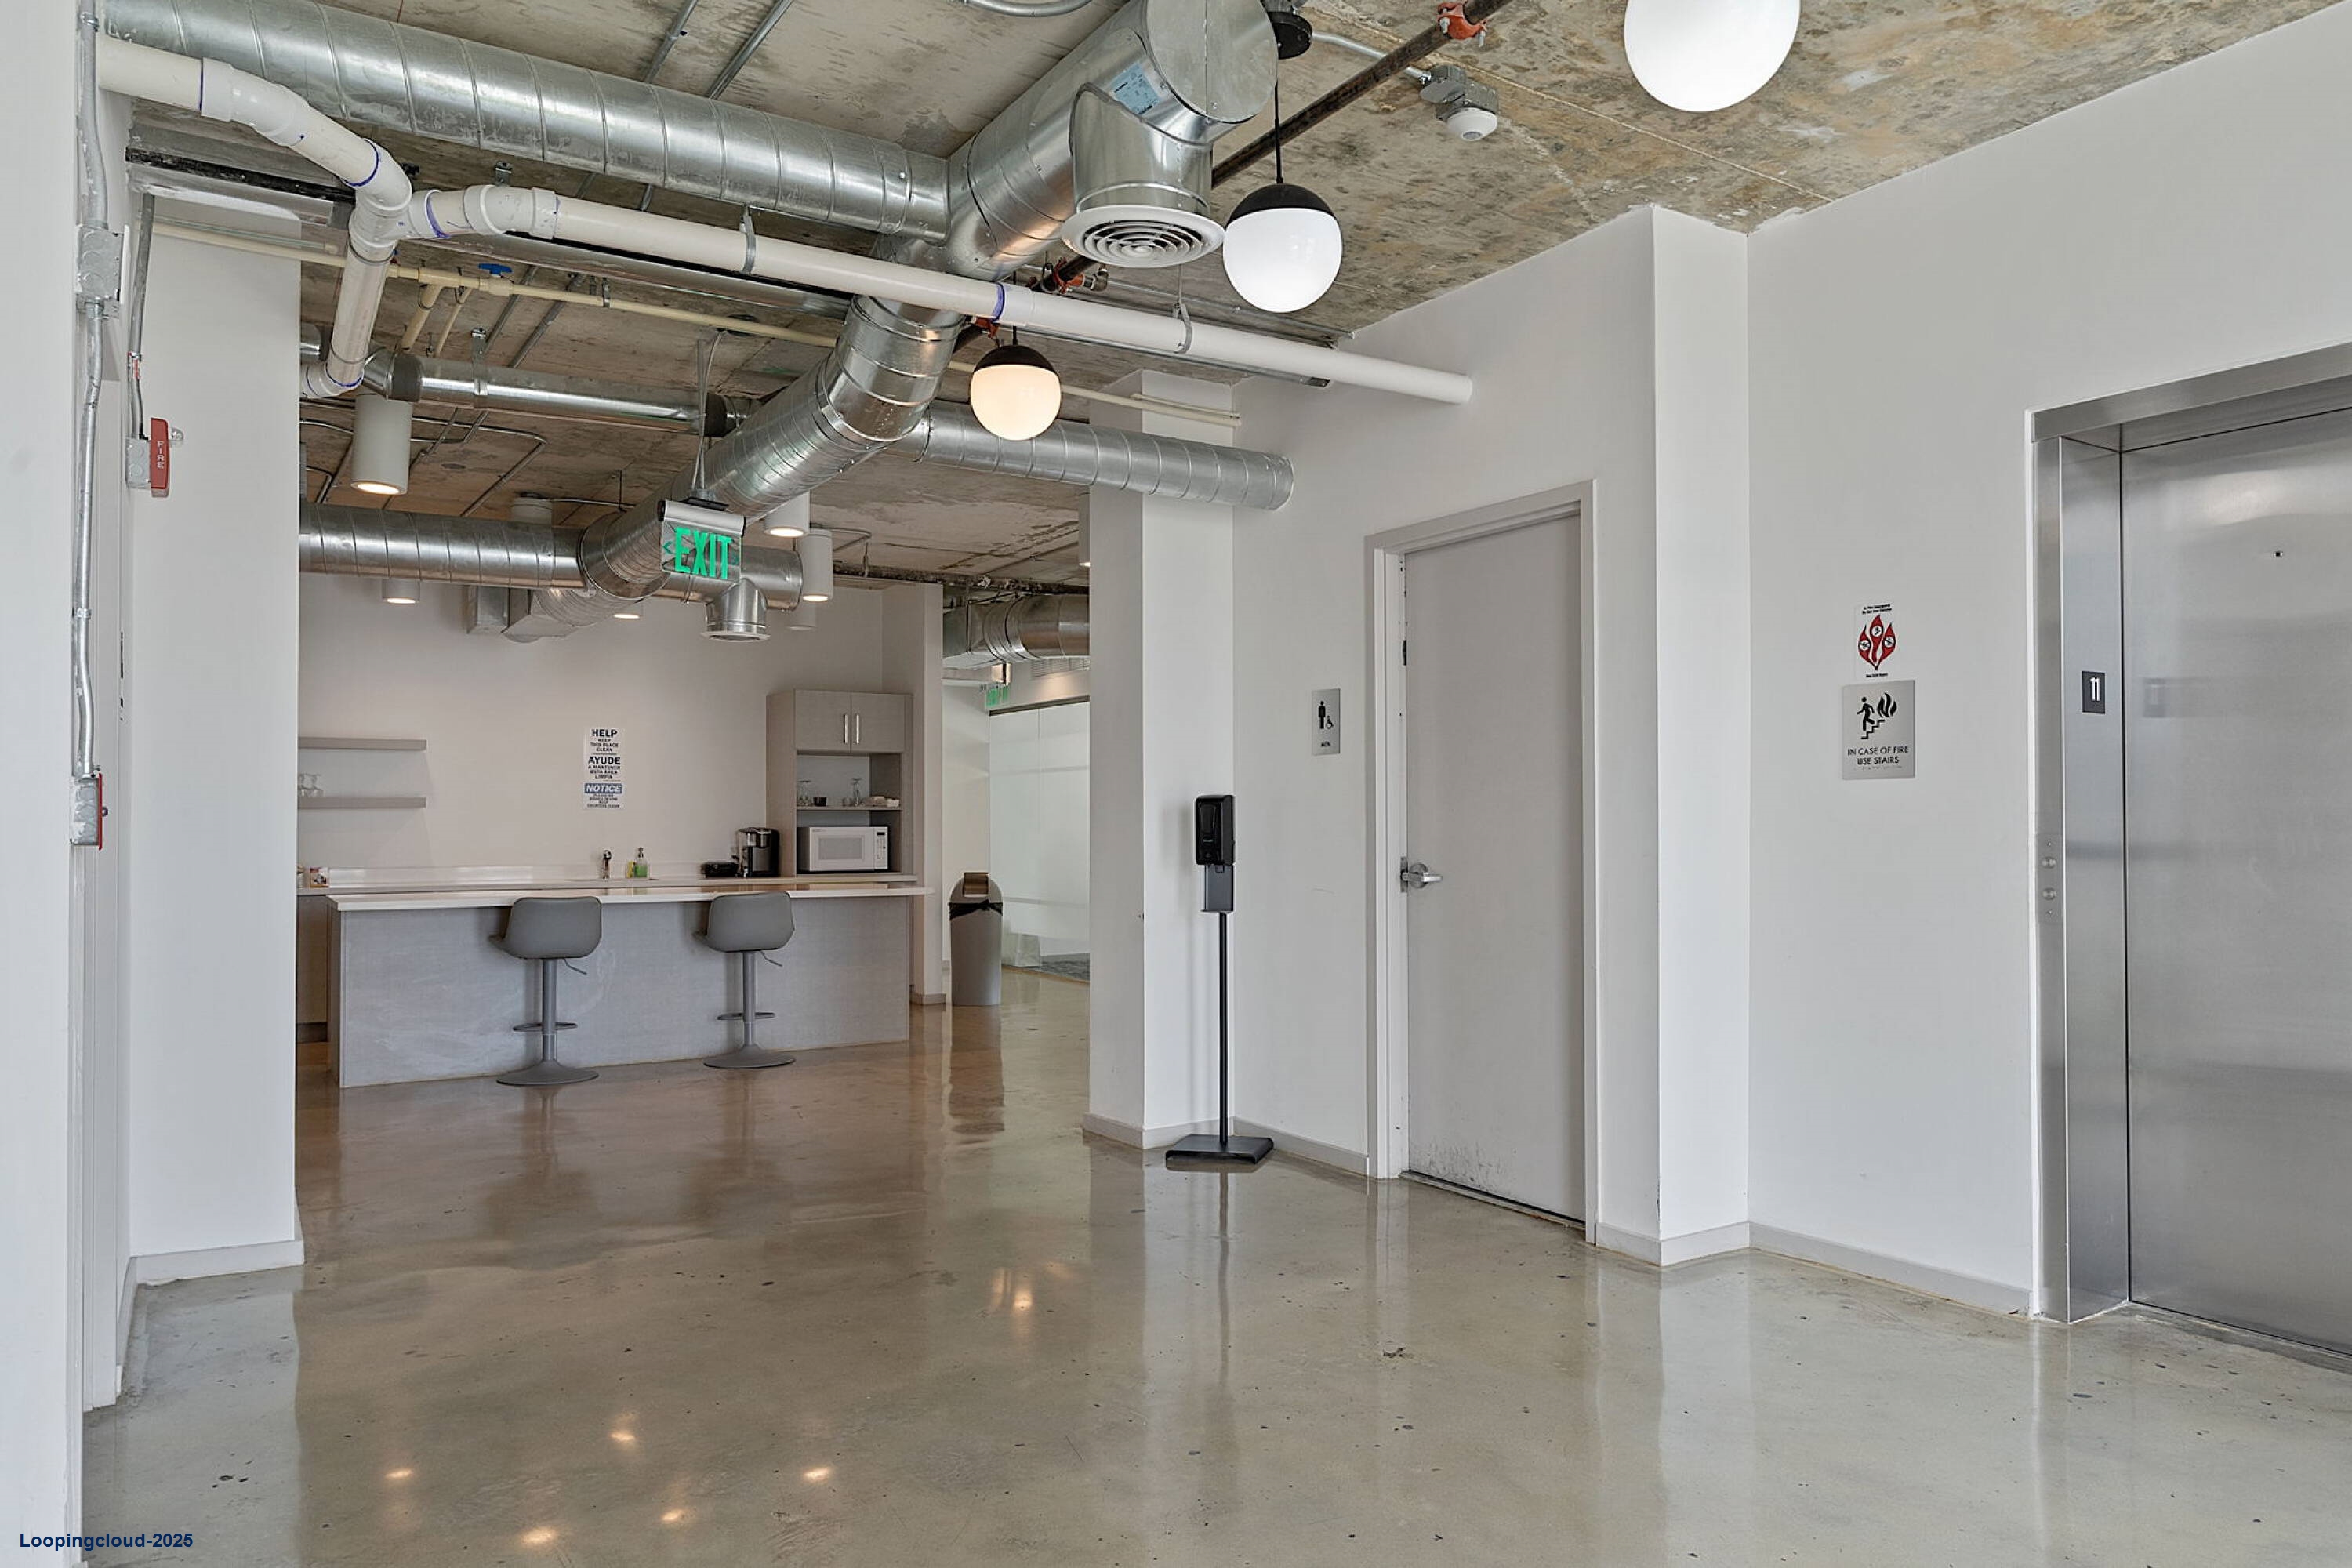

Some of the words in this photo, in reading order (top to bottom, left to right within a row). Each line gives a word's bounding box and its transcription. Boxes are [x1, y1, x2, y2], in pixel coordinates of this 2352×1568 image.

[675, 527, 732, 579] EXIT
[2090, 677, 2100, 701] 11
[588, 756, 621, 764] AYUDE
